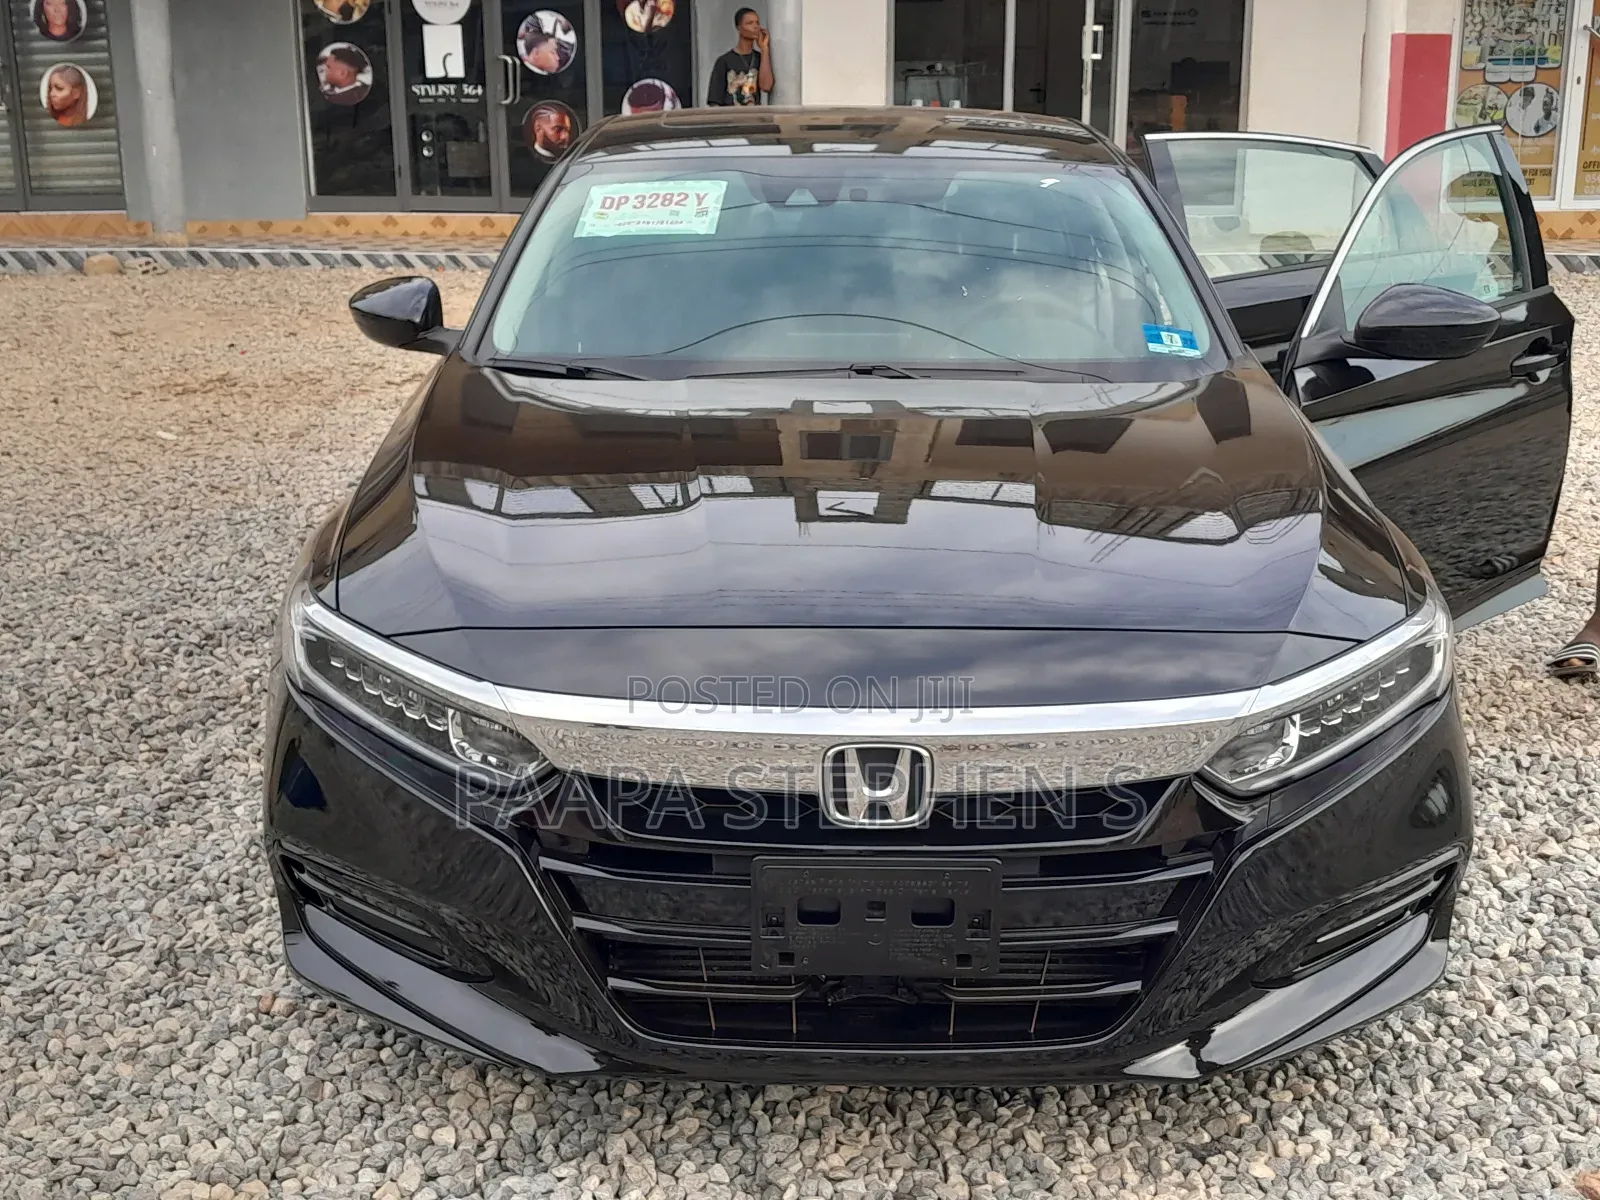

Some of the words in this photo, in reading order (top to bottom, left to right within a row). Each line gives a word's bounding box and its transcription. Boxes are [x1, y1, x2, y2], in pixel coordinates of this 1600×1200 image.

[411, 83, 457, 96] STYLIST
[600, 195, 630, 210] DP
[632, 192, 689, 209] 3282
[695, 193, 708, 207] Y
